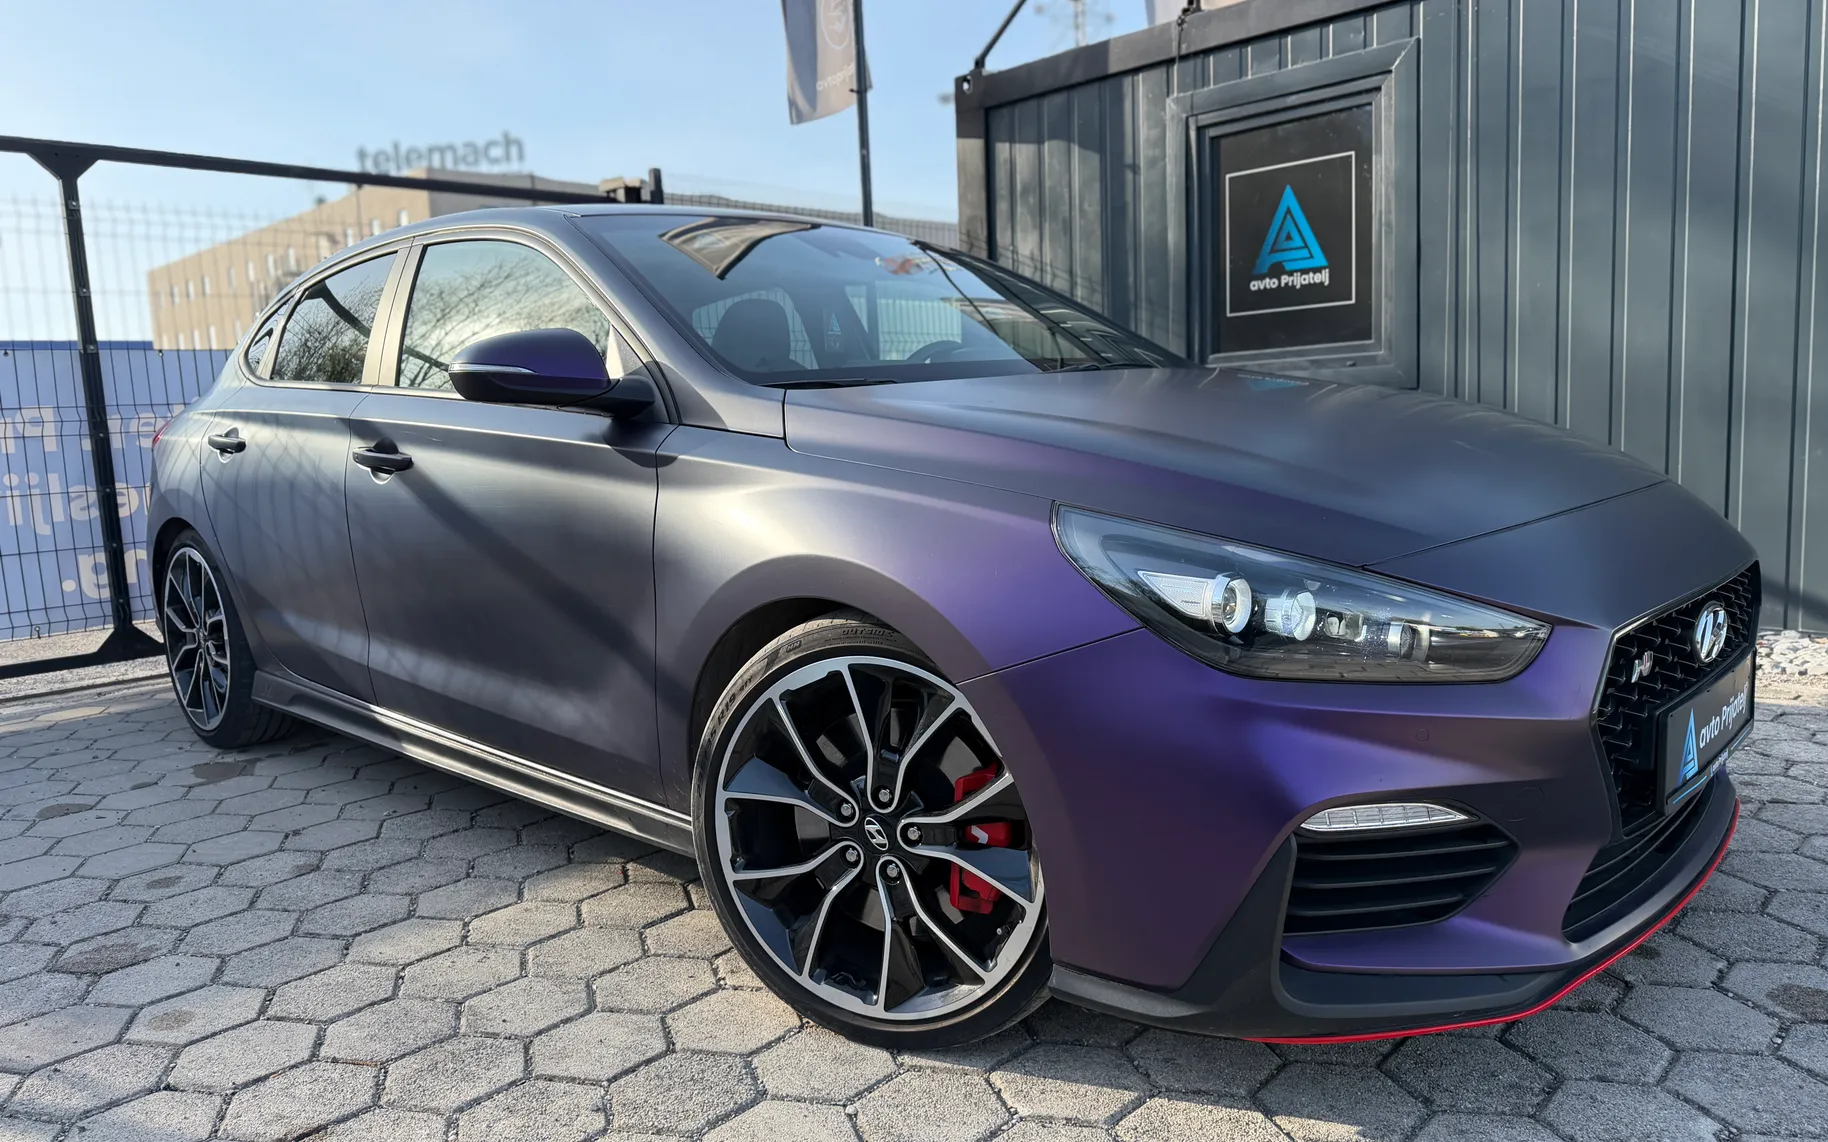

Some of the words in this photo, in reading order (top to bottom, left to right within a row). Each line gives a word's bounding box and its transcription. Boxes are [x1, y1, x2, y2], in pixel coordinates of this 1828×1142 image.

[357, 131, 526, 174] telemach
[1249, 277, 1279, 291] avto
[1281, 268, 1330, 289] Prijatelj
[1699, 715, 1721, 749] avto
[1721, 681, 1749, 730] Prijatelj
